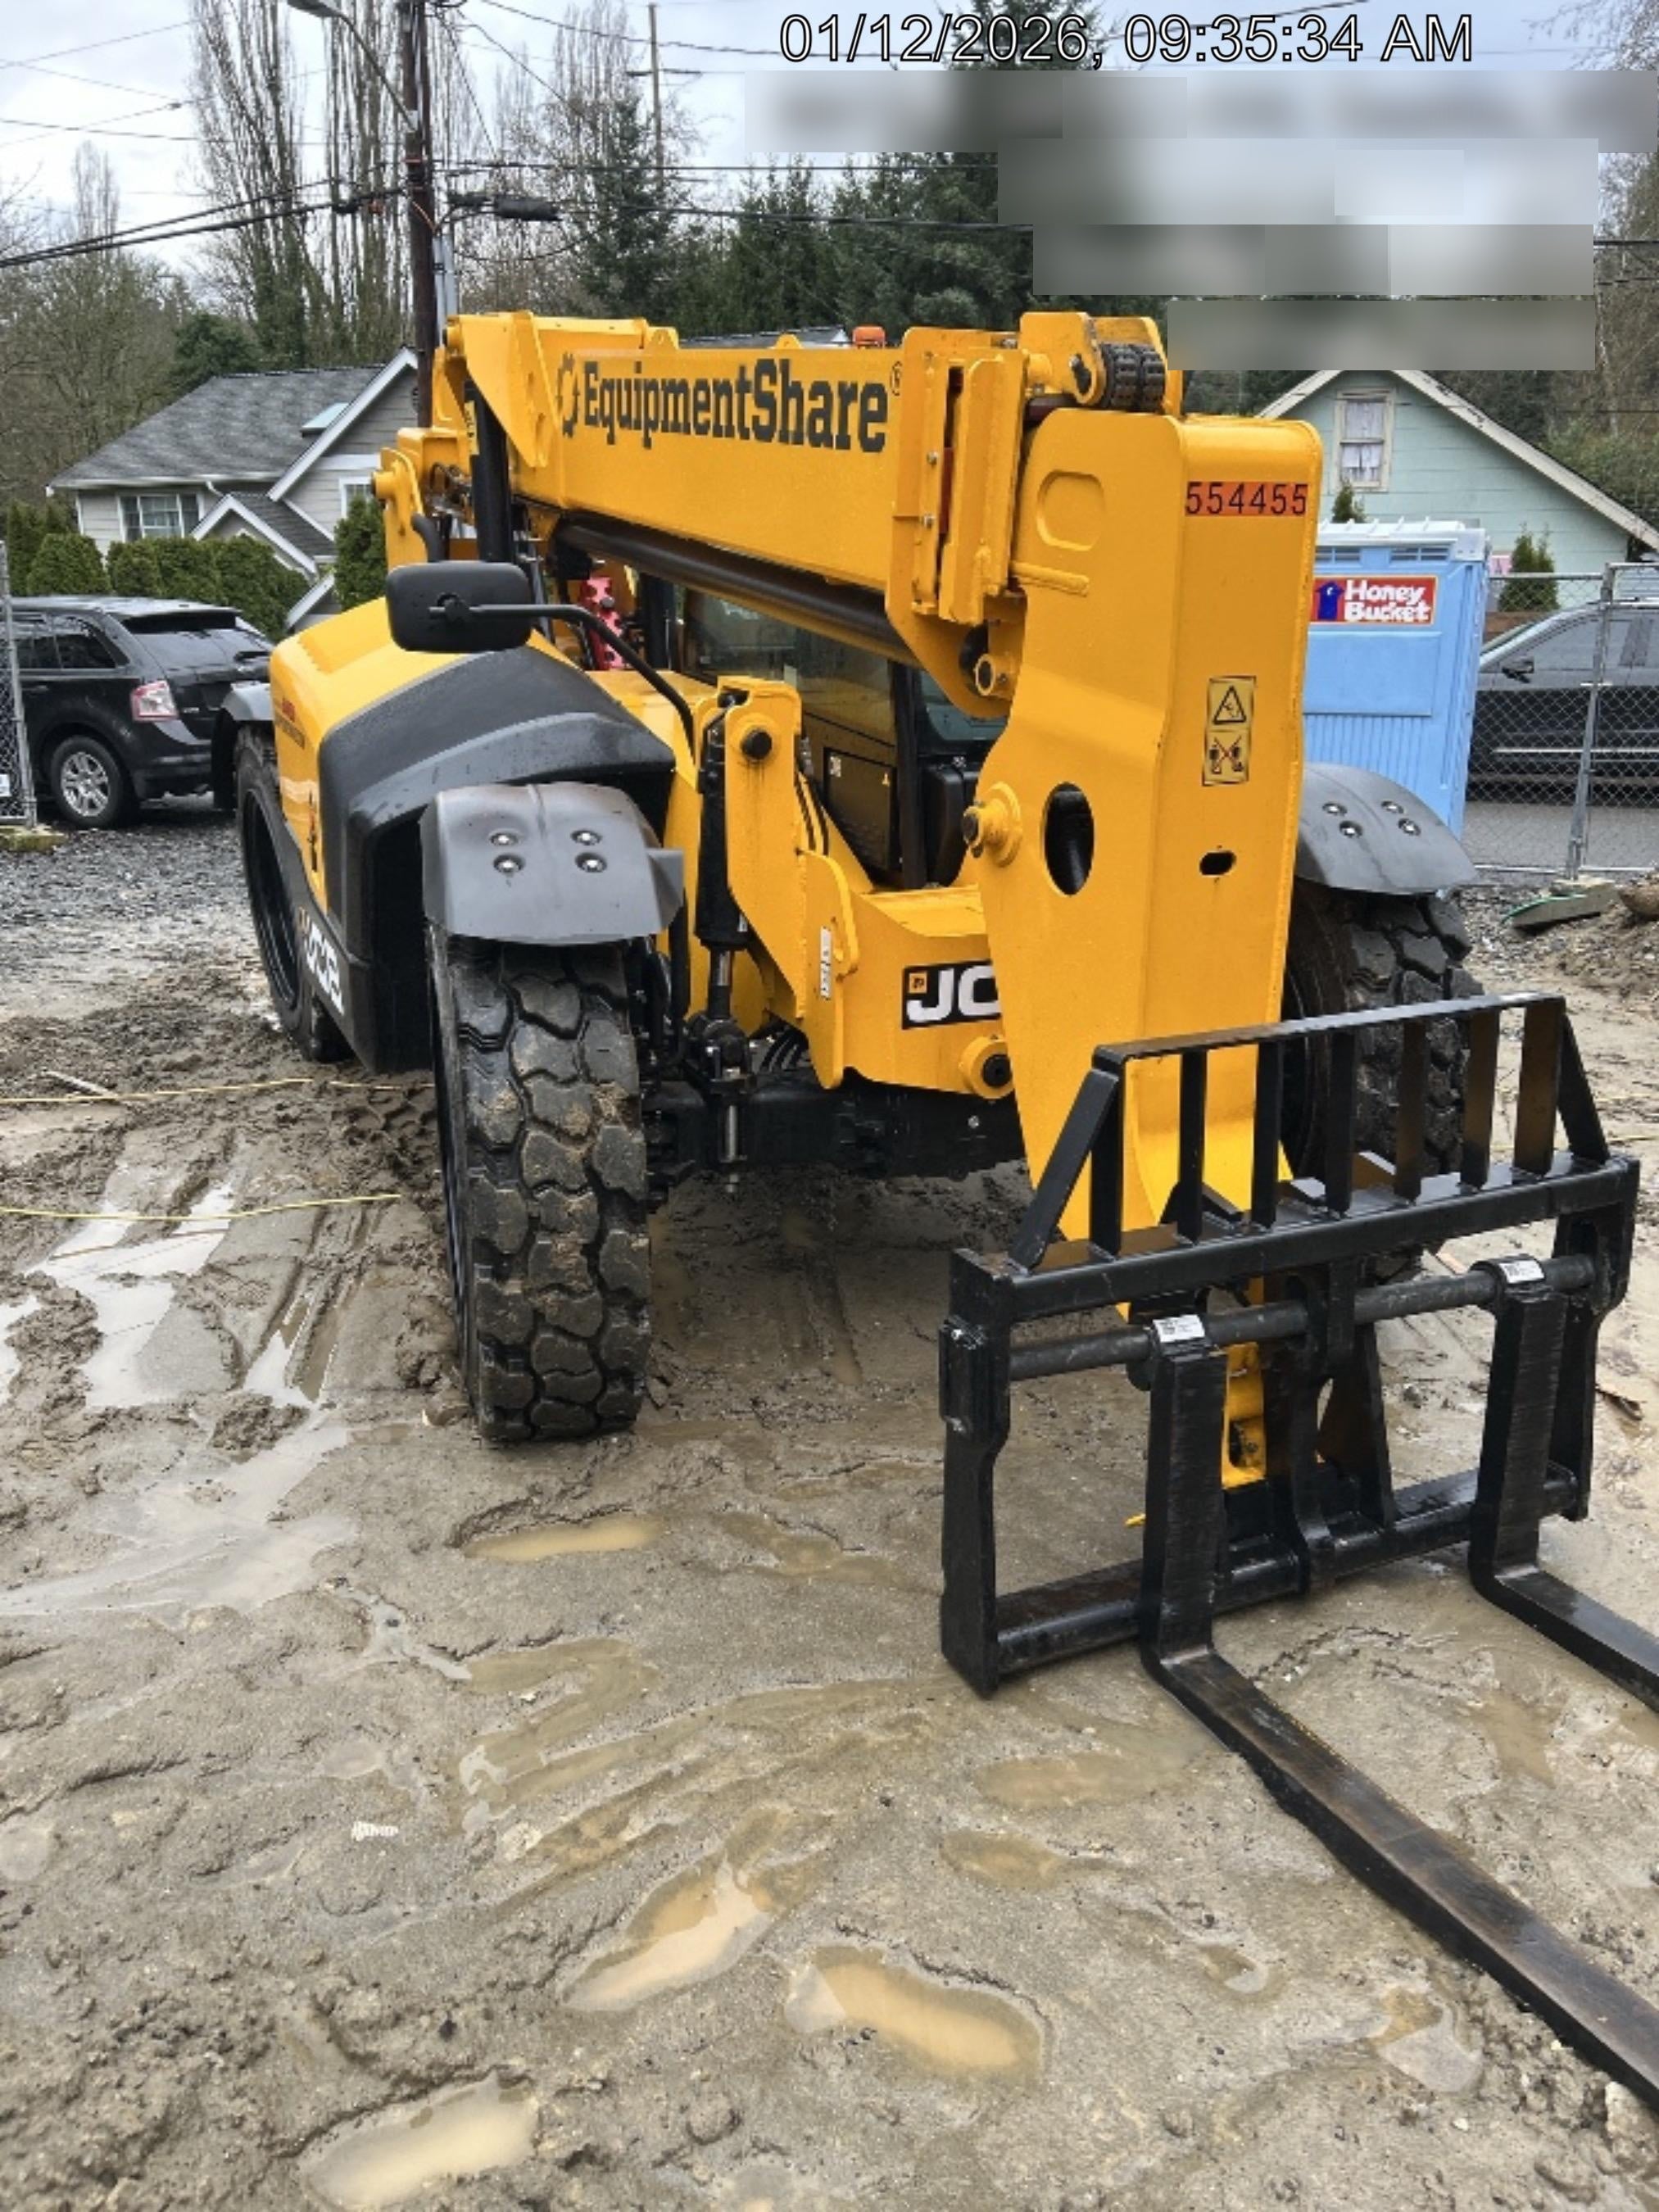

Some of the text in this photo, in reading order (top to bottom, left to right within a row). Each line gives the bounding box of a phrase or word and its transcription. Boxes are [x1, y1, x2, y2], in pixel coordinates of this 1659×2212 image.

[583, 358, 888, 453] EquipmentShare
[1185, 482, 1308, 515] 554455
[1344, 578, 1426, 606] Honey
[1344, 601, 1432, 622] Bucket
[905, 964, 1001, 1023] JC
